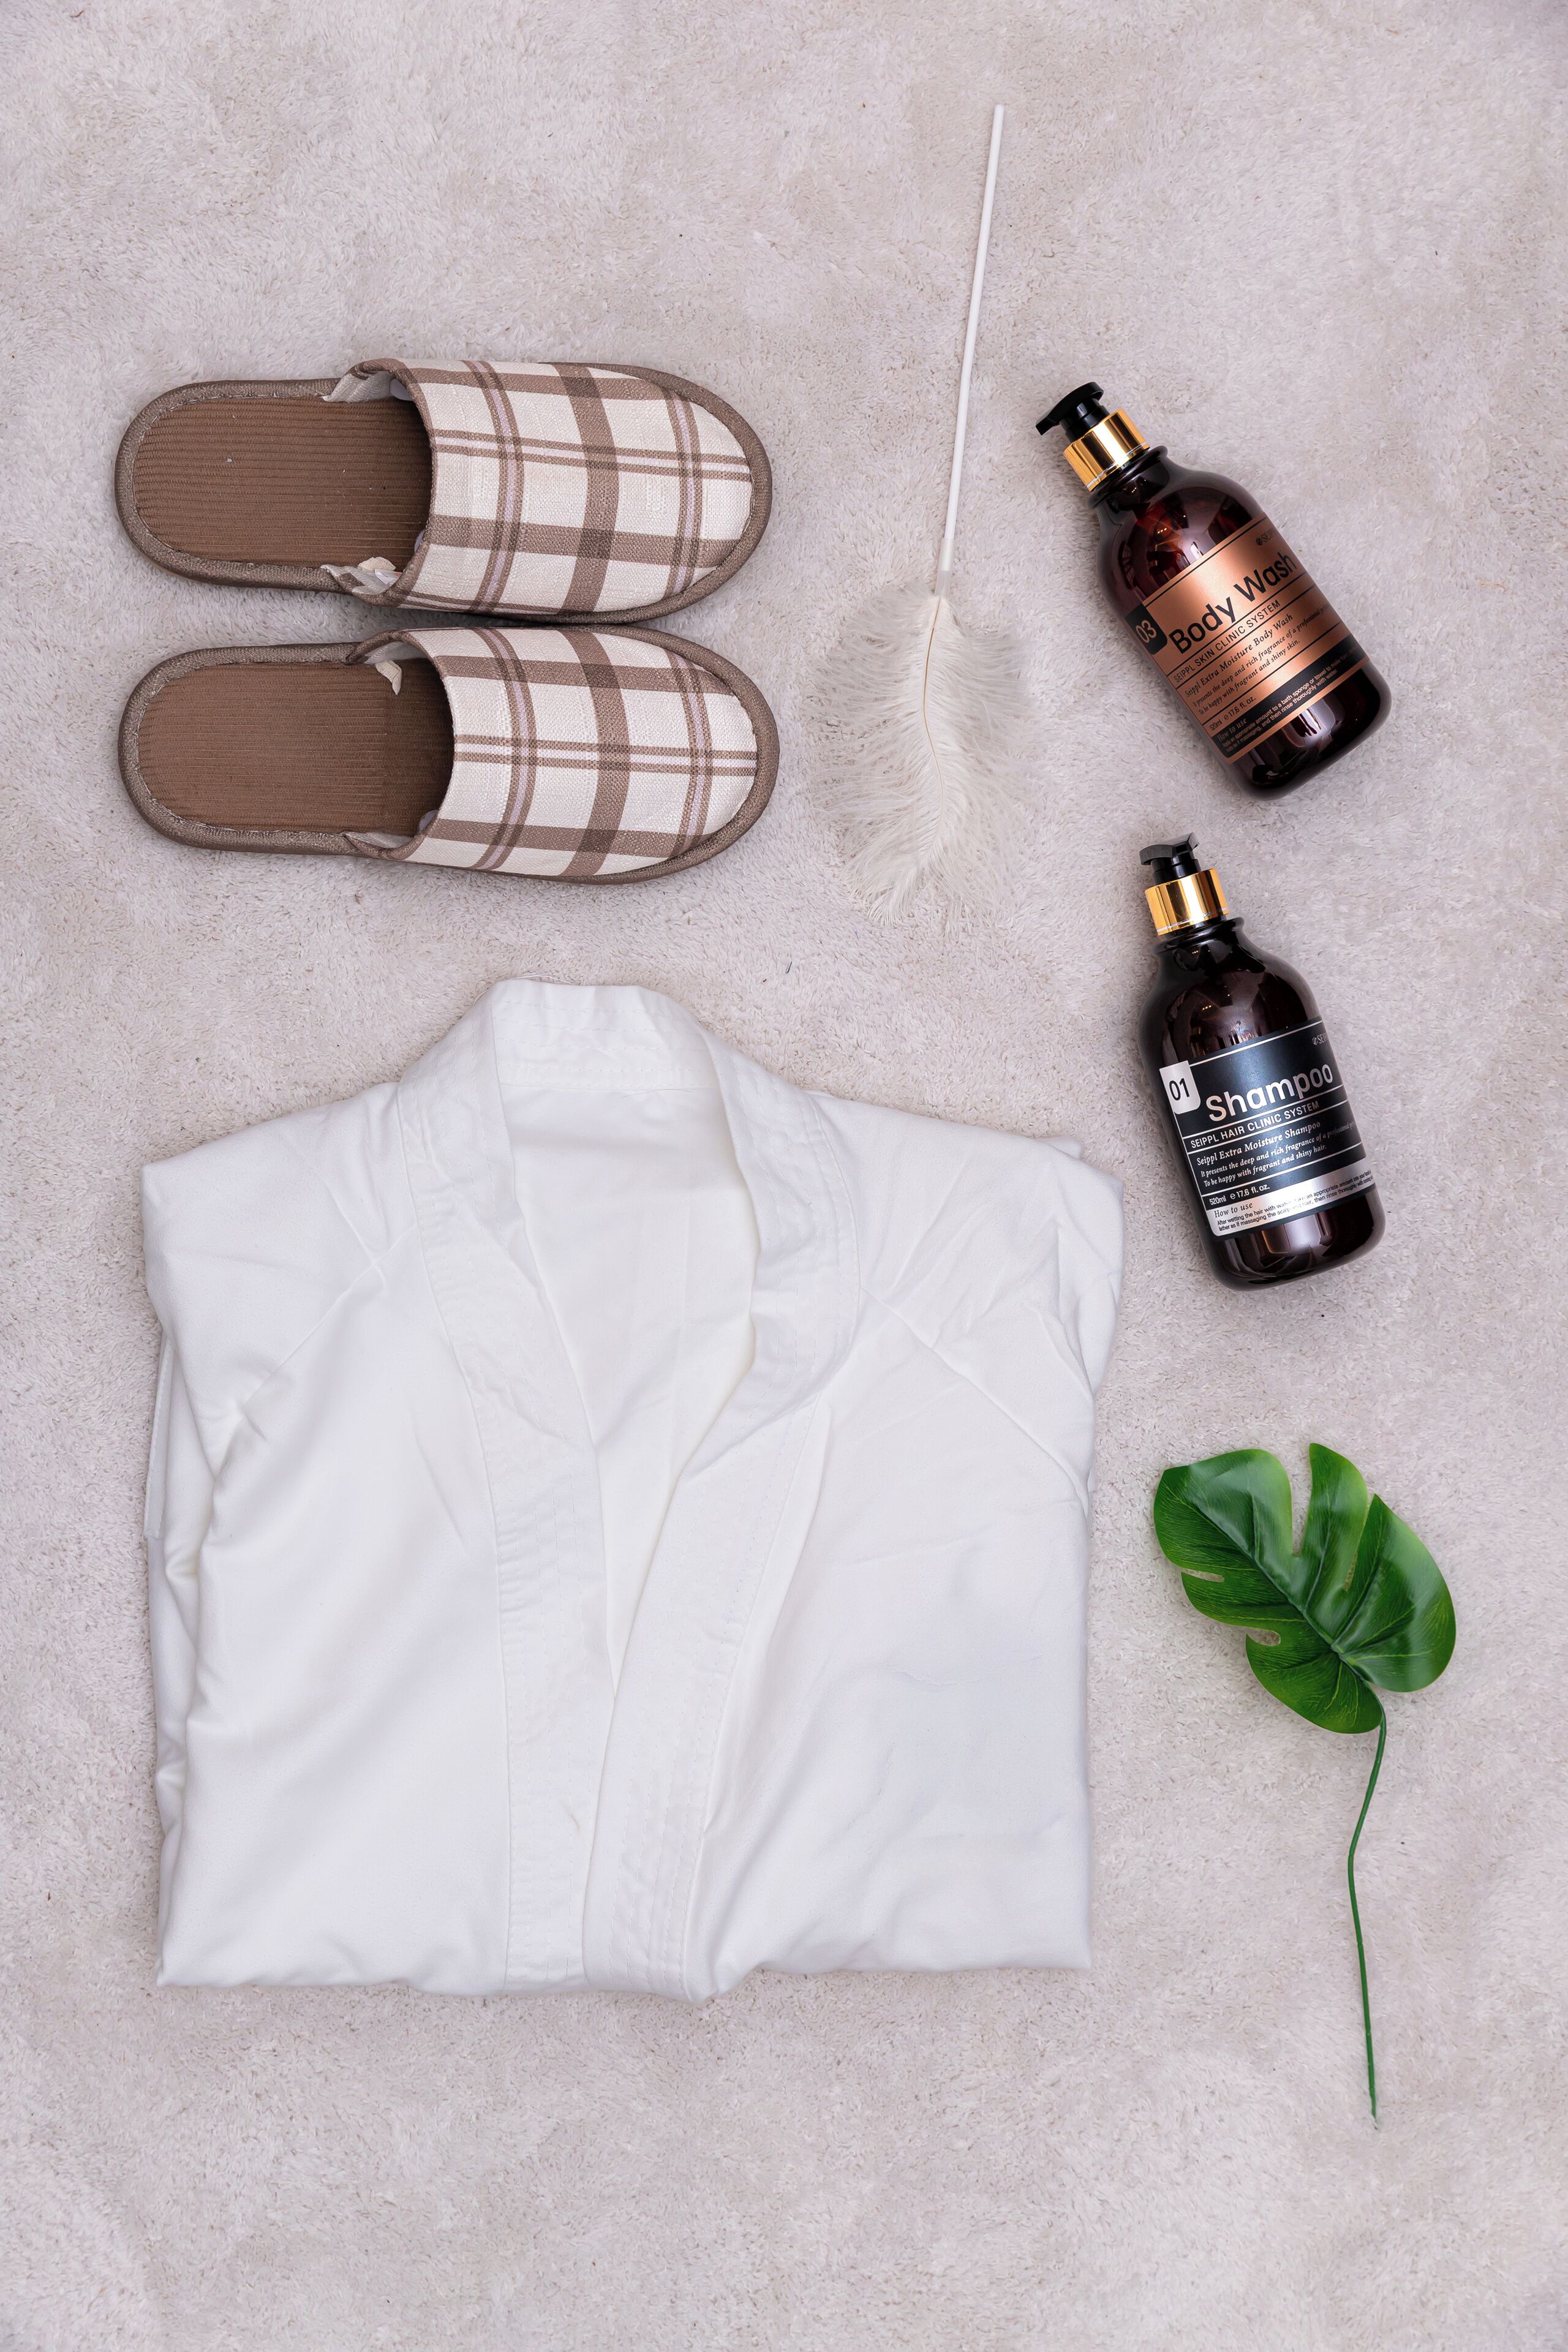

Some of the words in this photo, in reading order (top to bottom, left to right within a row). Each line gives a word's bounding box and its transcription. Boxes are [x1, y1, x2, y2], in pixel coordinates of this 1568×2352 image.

[1169, 597, 1235, 653] Body
[1232, 552, 1297, 603] Wash
[1135, 619, 1157, 643] 03
[1173, 664, 1195, 682] SEIPPL
[1194, 648, 1215, 666] SKIN
[1215, 625, 1246, 651] CLINIC
[1245, 600, 1280, 628] SYSTEM
[1184, 680, 1201, 698] Seippl
[1199, 669, 1219, 686] Extra
[1219, 644, 1253, 671] Moisture
[1253, 628, 1273, 646] Body
[1272, 613, 1293, 630] Wash
[1207, 695, 1223, 709] happy
[1221, 686, 1234, 698] with
[1234, 668, 1258, 692] fragrant
[1258, 658, 1270, 671] and
[1270, 647, 1286, 663] shiny
[1286, 639, 1300, 650] skin.
[1212, 684, 1221, 693] the
[1220, 674, 1234, 687] deep
[1234, 664, 1246, 676] and
[1245, 655, 1258, 668] rich
[1257, 636, 1286, 660] fragrance
[1285, 629, 1292, 638] of
[1228, 706, 1240, 717] 17.6
[1245, 696, 1256, 704] oz.
[1255, 709, 1273, 724] amount
[1280, 694, 1293, 704] bath
[1292, 682, 1310, 697] sponge
[1314, 668, 1327, 680] towel
[1261, 718, 1270, 727] and
[1270, 710, 1281, 720] then
[1280, 701, 1294, 712] rinse
[1292, 684, 1317, 704] thoroughly
[1315, 677, 1327, 687] with
[1235, 717, 1247, 728] use
[1168, 1078, 1189, 1101] 01
[1206, 1065, 1332, 1121] Shampoo
[1190, 1134, 1219, 1148] SEIPPL
[1220, 1125, 1245, 1139] HAIR
[1246, 1113, 1282, 1131] CLINIC
[1283, 1101, 1317, 1120] SYSTEM
[1196, 1152, 1218, 1166] Seippl
[1218, 1147, 1242, 1159] Extra
[1243, 1134, 1283, 1152] Moisture
[1284, 1121, 1320, 1139] Shampoo
[1205, 1165, 1228, 1177] presents
[1239, 1156, 1255, 1166] deep
[1255, 1150, 1270, 1161] and
[1270, 1146, 1284, 1156] rich
[1284, 1137, 1314, 1153] fragrance
[1315, 1133, 1322, 1142] of
[1217, 1174, 1236, 1183] happy
[1236, 1167, 1251, 1178] with
[1252, 1159, 1280, 1175] fragrant
[1281, 1153, 1295, 1164] and
[1295, 1149, 1312, 1159] shiny
[1312, 1144, 1327, 1153] hair.
[1208, 1194, 1227, 1205] 520ml
[1236, 1188, 1250, 1198] 17.6
[1250, 1185, 1259, 1194] fl.
[1213, 1208, 1229, 1218] How
[1240, 1202, 1253, 1211] use
[1227, 1215, 1245, 1223] wetting
[1264, 1204, 1276, 1213] with
[1313, 1184, 1339, 1197] appropriate
[1240, 1214, 1267, 1226] massaging
